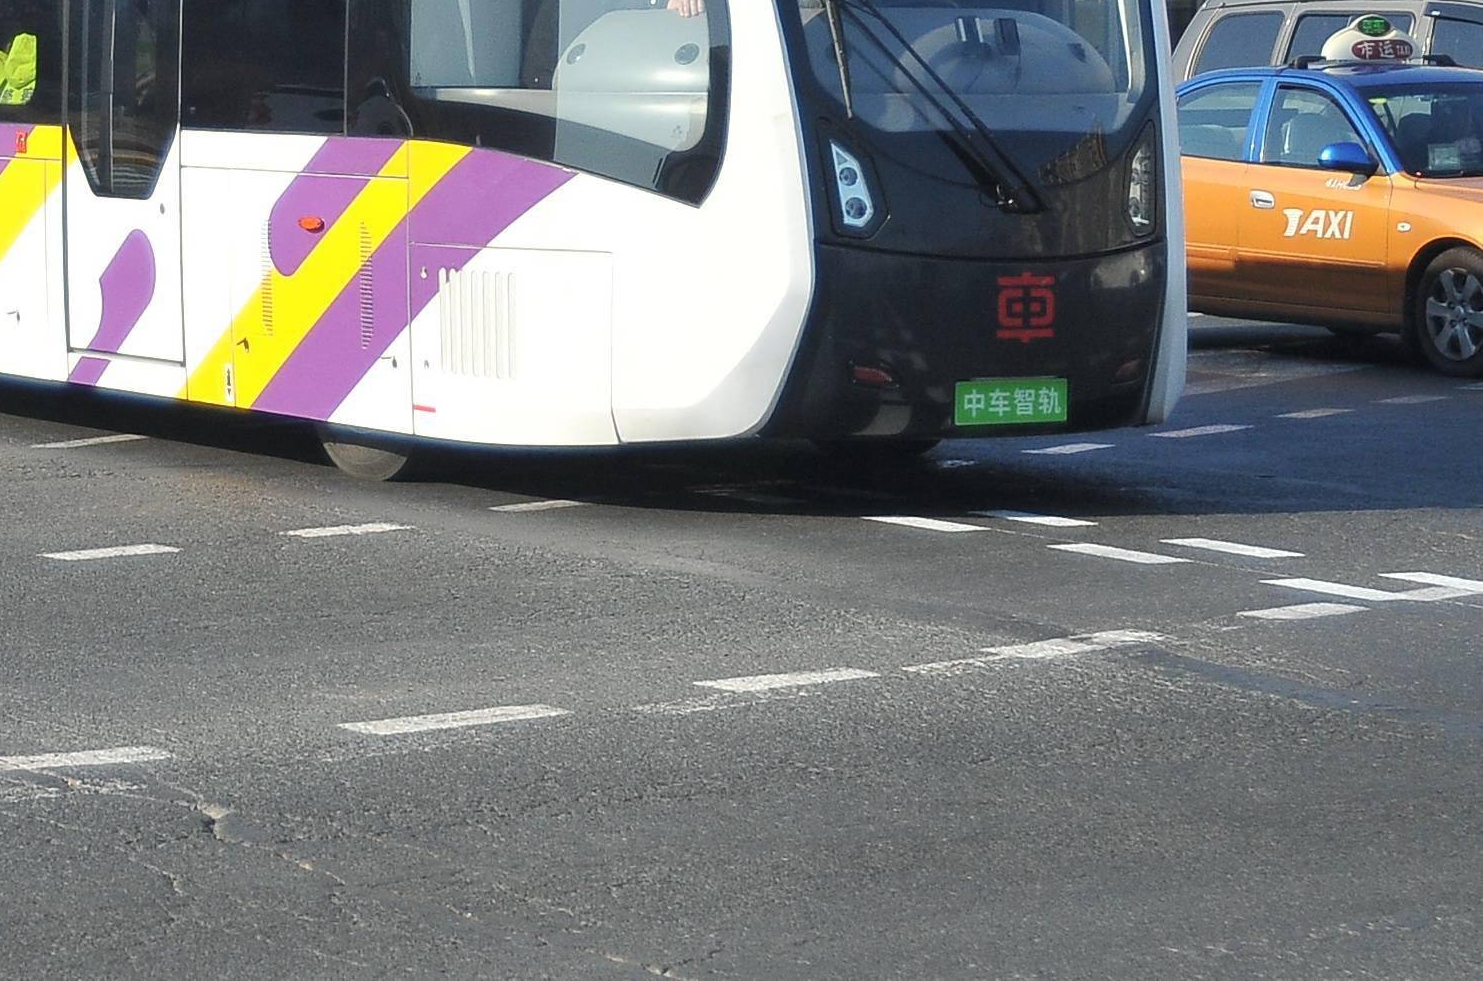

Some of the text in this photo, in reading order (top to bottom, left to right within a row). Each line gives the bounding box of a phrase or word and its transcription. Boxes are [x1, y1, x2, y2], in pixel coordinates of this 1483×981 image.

[1282, 207, 1354, 239] TAXI
[963, 387, 1062, 418] 中车智轨
